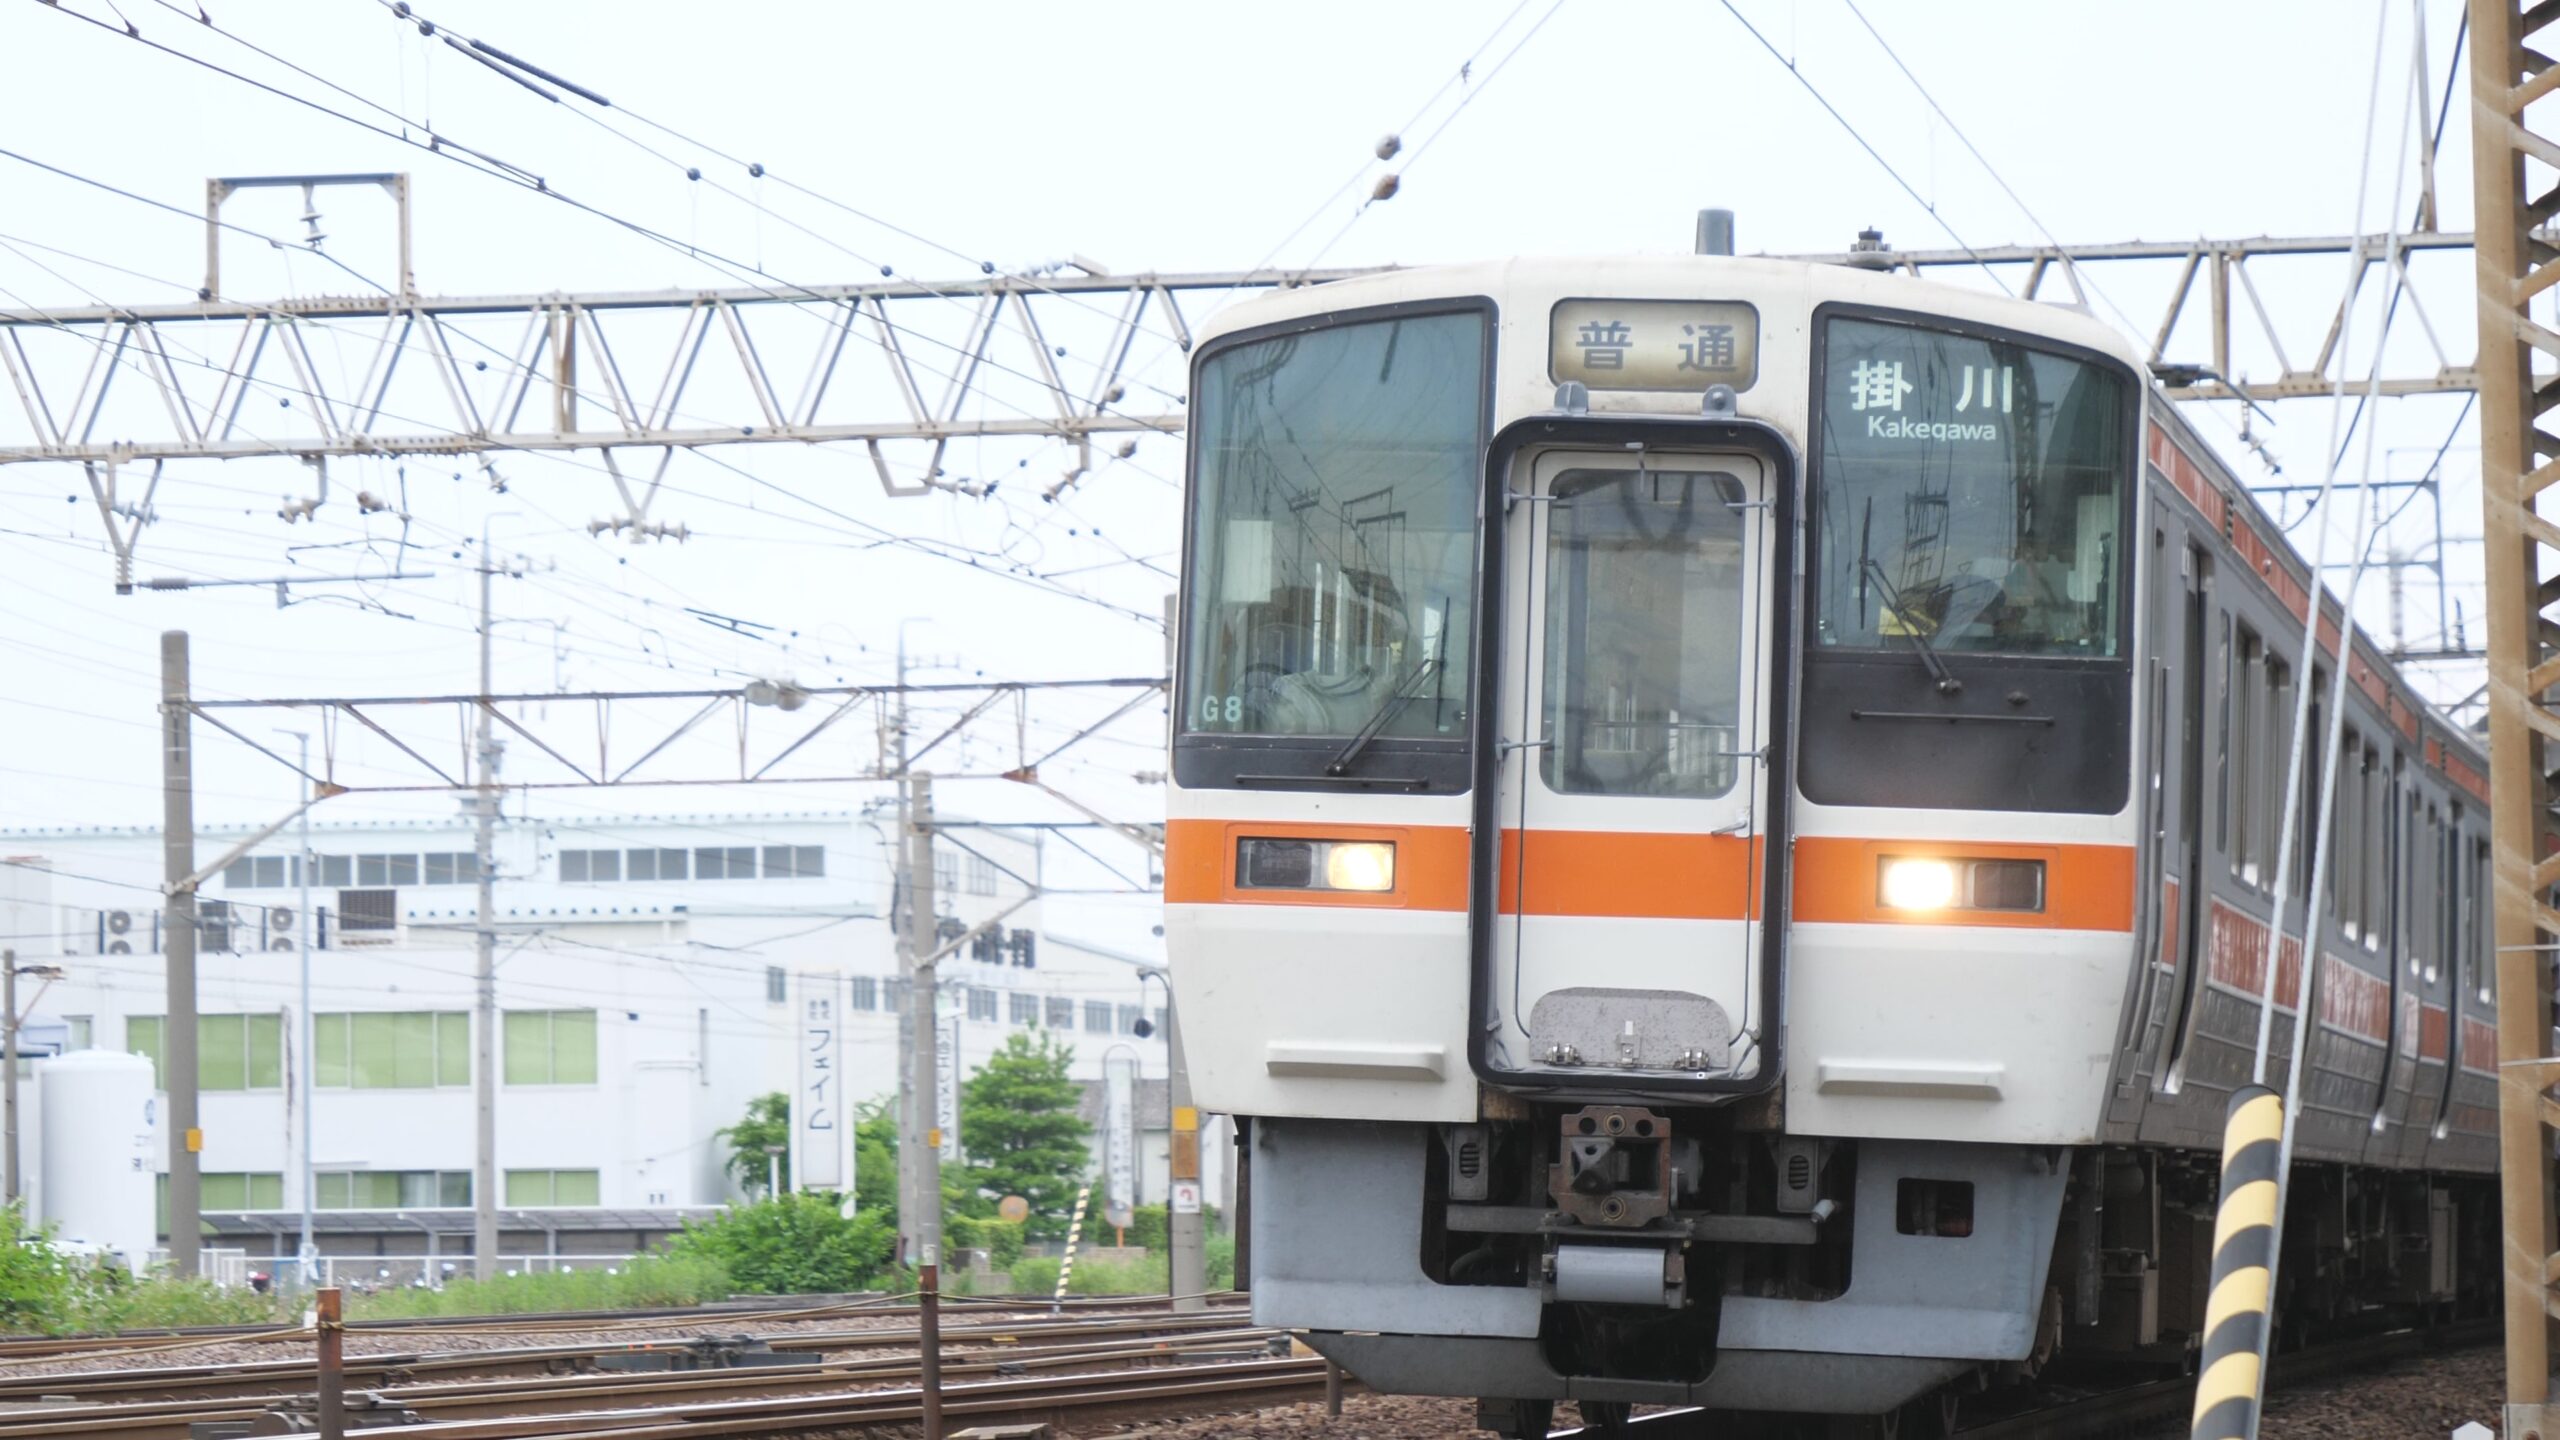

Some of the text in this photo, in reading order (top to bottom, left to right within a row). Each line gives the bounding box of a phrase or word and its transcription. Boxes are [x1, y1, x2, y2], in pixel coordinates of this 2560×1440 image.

[1576, 320, 1737, 372] 普通
[1850, 360, 2013, 413] 掛川
[1202, 695, 1242, 722] G8
[809, 1030, 832, 1129] フェイム
